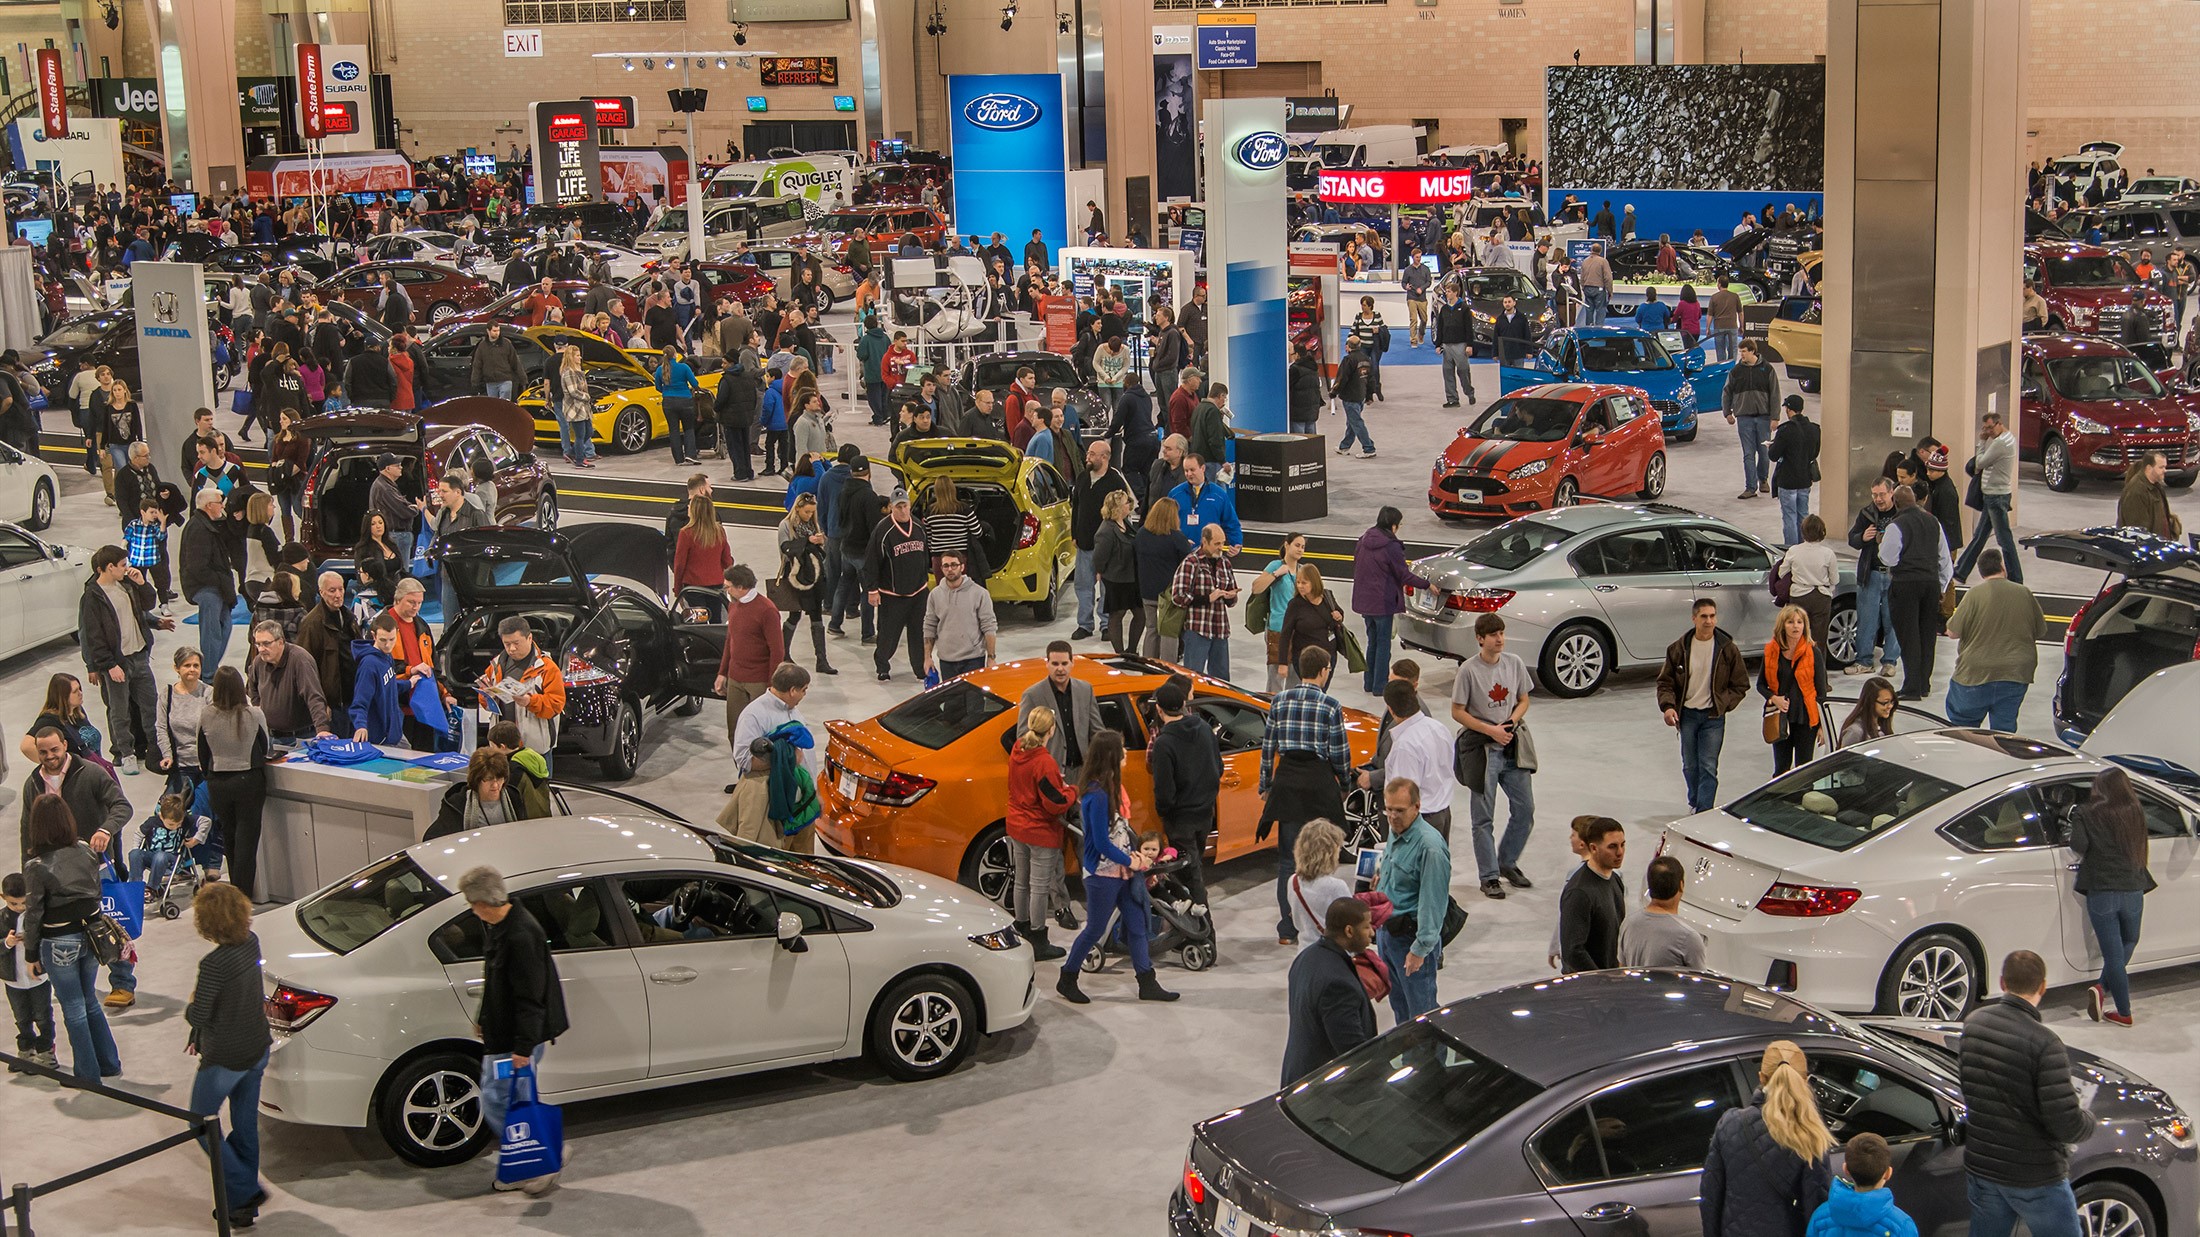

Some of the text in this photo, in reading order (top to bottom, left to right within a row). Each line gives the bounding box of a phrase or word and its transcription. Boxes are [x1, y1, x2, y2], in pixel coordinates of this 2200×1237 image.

[1419, 10, 1436, 20] MEN
[1498, 8, 1527, 18] WOMEN
[507, 34, 539, 53] EXIT
[777, 71, 819, 84] REFRESH
[325, 84, 367, 93] SUBARU
[976, 97, 1022, 122] Ford
[1295, 107, 1336, 117] RAM
[551, 127, 586, 139] GARAGE
[1250, 137, 1283, 164] Ford
[559, 150, 581, 164] LIFE
[559, 168, 584, 178] OF YOUR
[783, 169, 843, 191] QUIGLEY
[556, 177, 588, 197] LIFE
[143, 326, 192, 339] HONDA
[1238, 483, 1264, 492] LANDFILL
[1264, 485, 1282, 493] ONLY
[1288, 480, 1325, 492] LANDFILL ONLY
